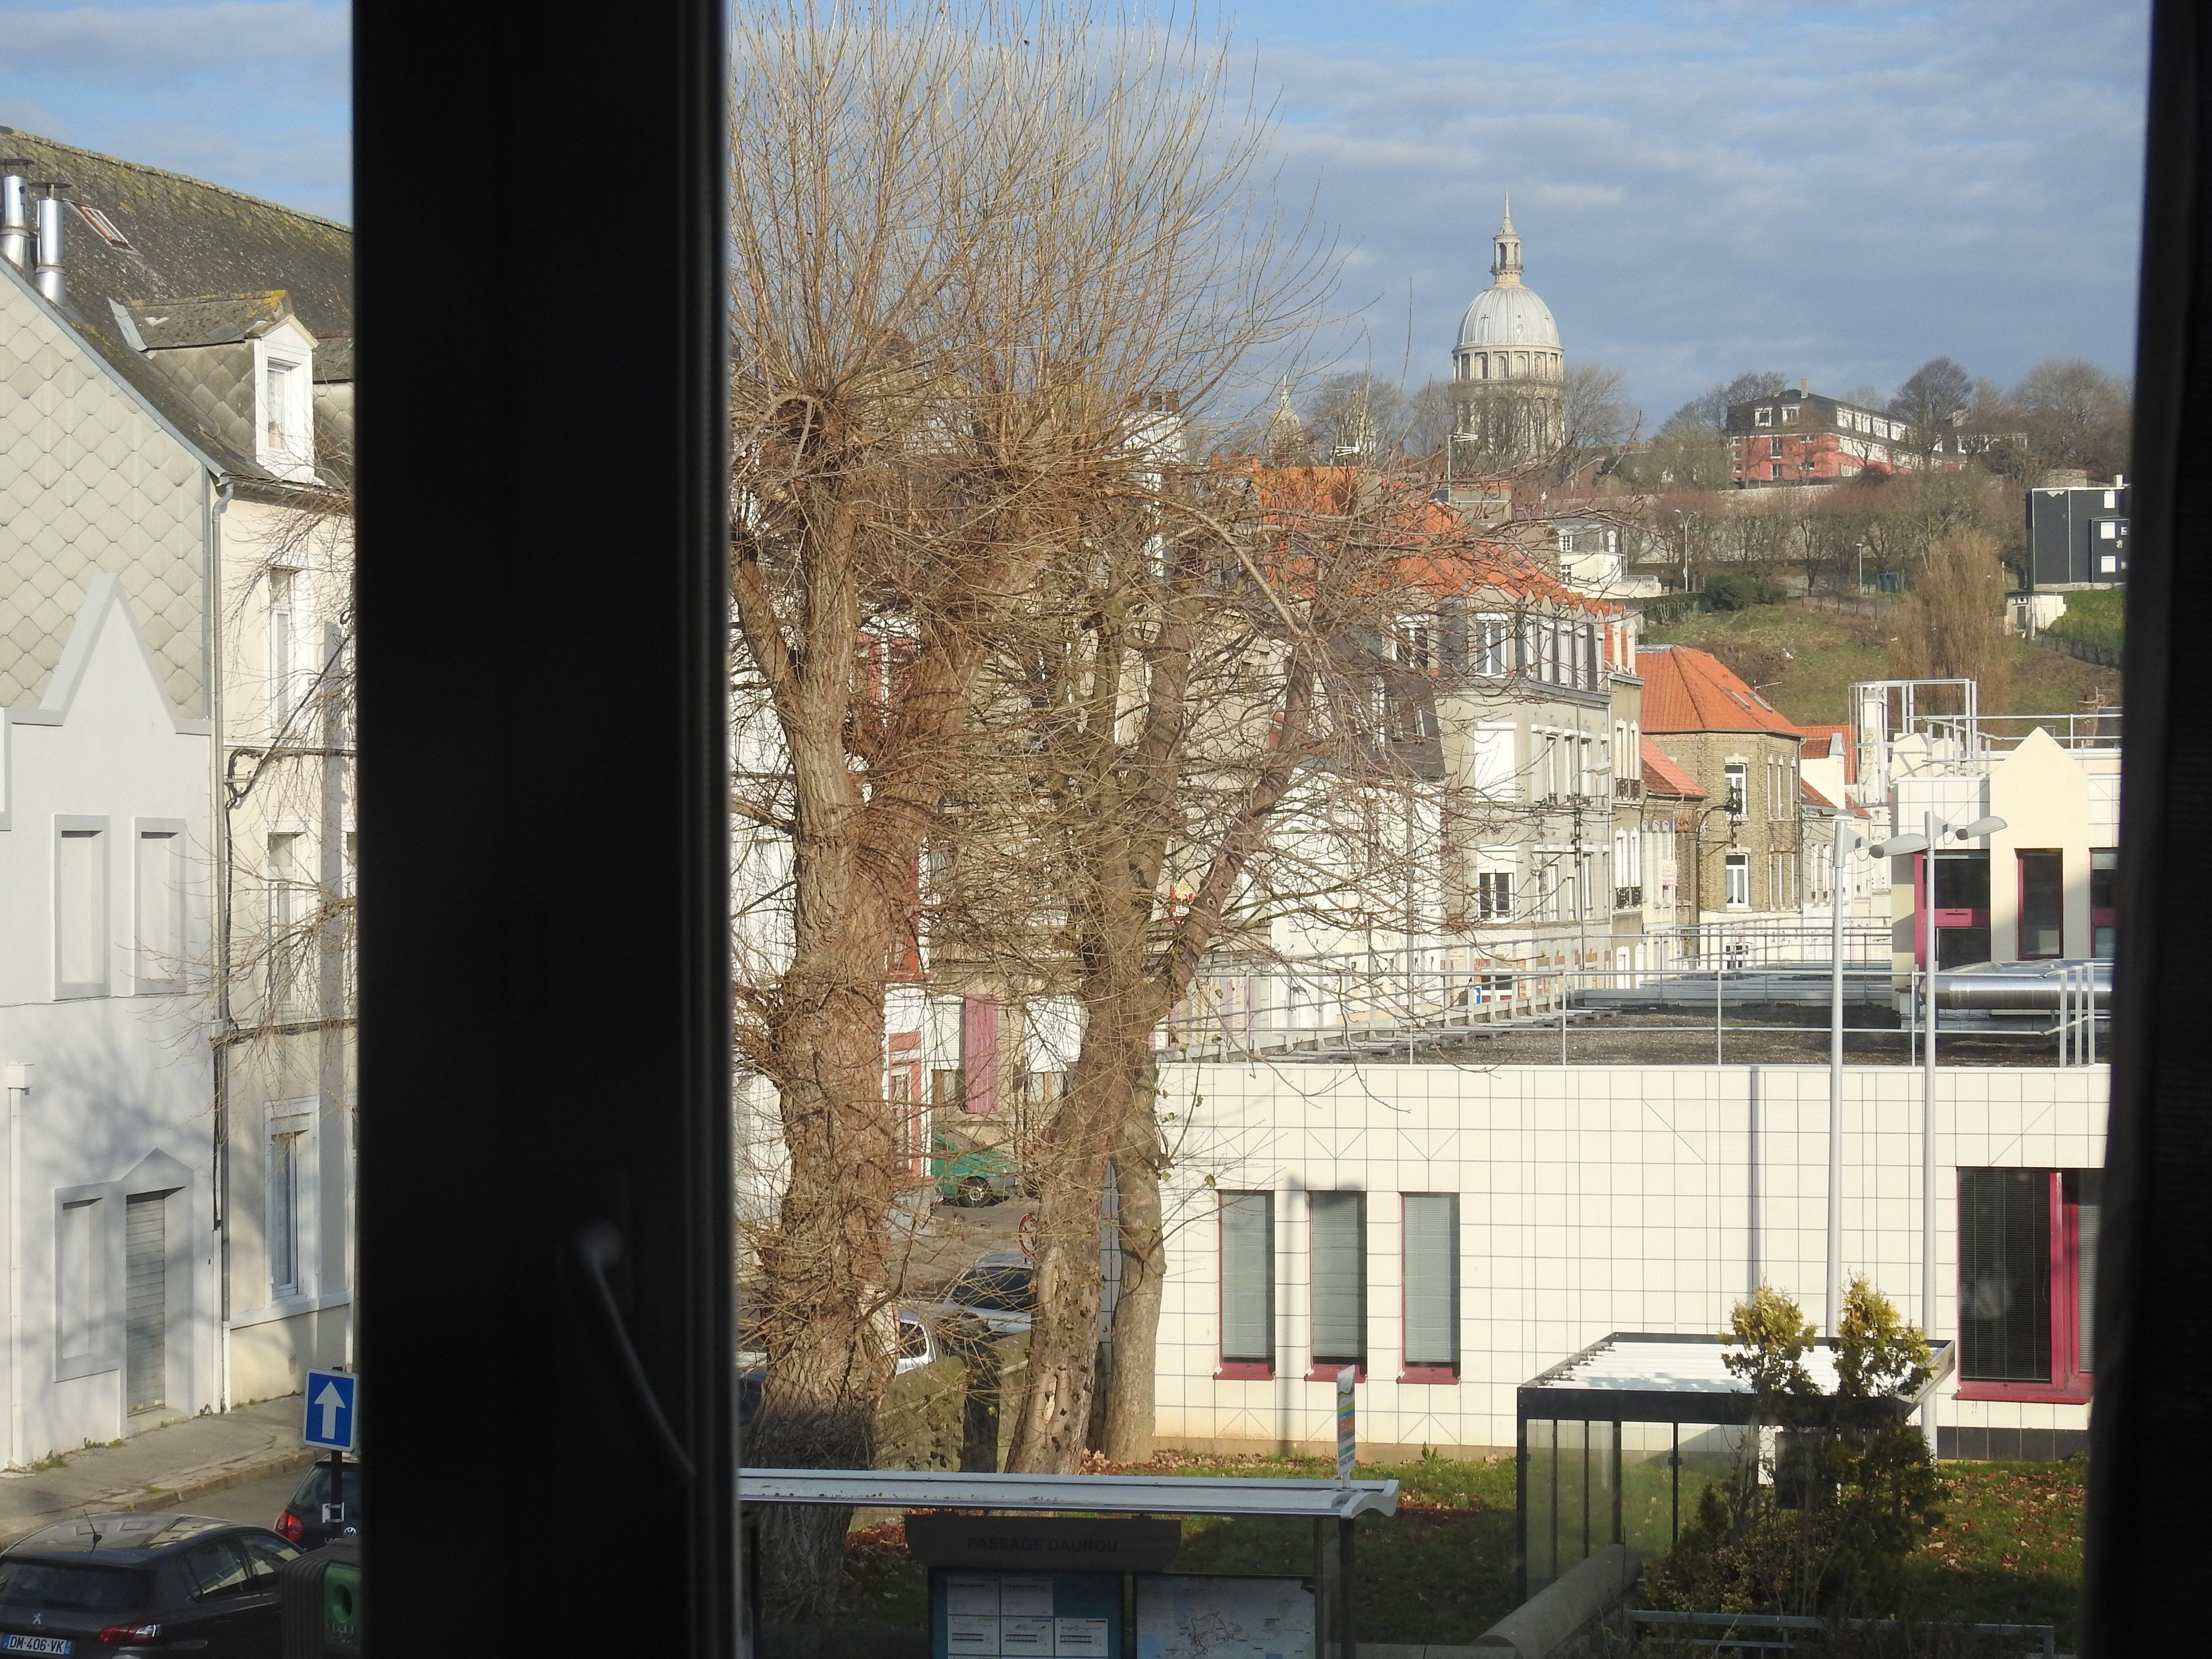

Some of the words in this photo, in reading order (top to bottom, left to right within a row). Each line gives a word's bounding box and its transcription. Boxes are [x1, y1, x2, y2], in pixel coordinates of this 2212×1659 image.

[967, 1537, 1043, 1551] PASSAGE
[1048, 1539, 1118, 1553] DAUNOU
[9, 1636, 65, 1653] DM-406-VK
